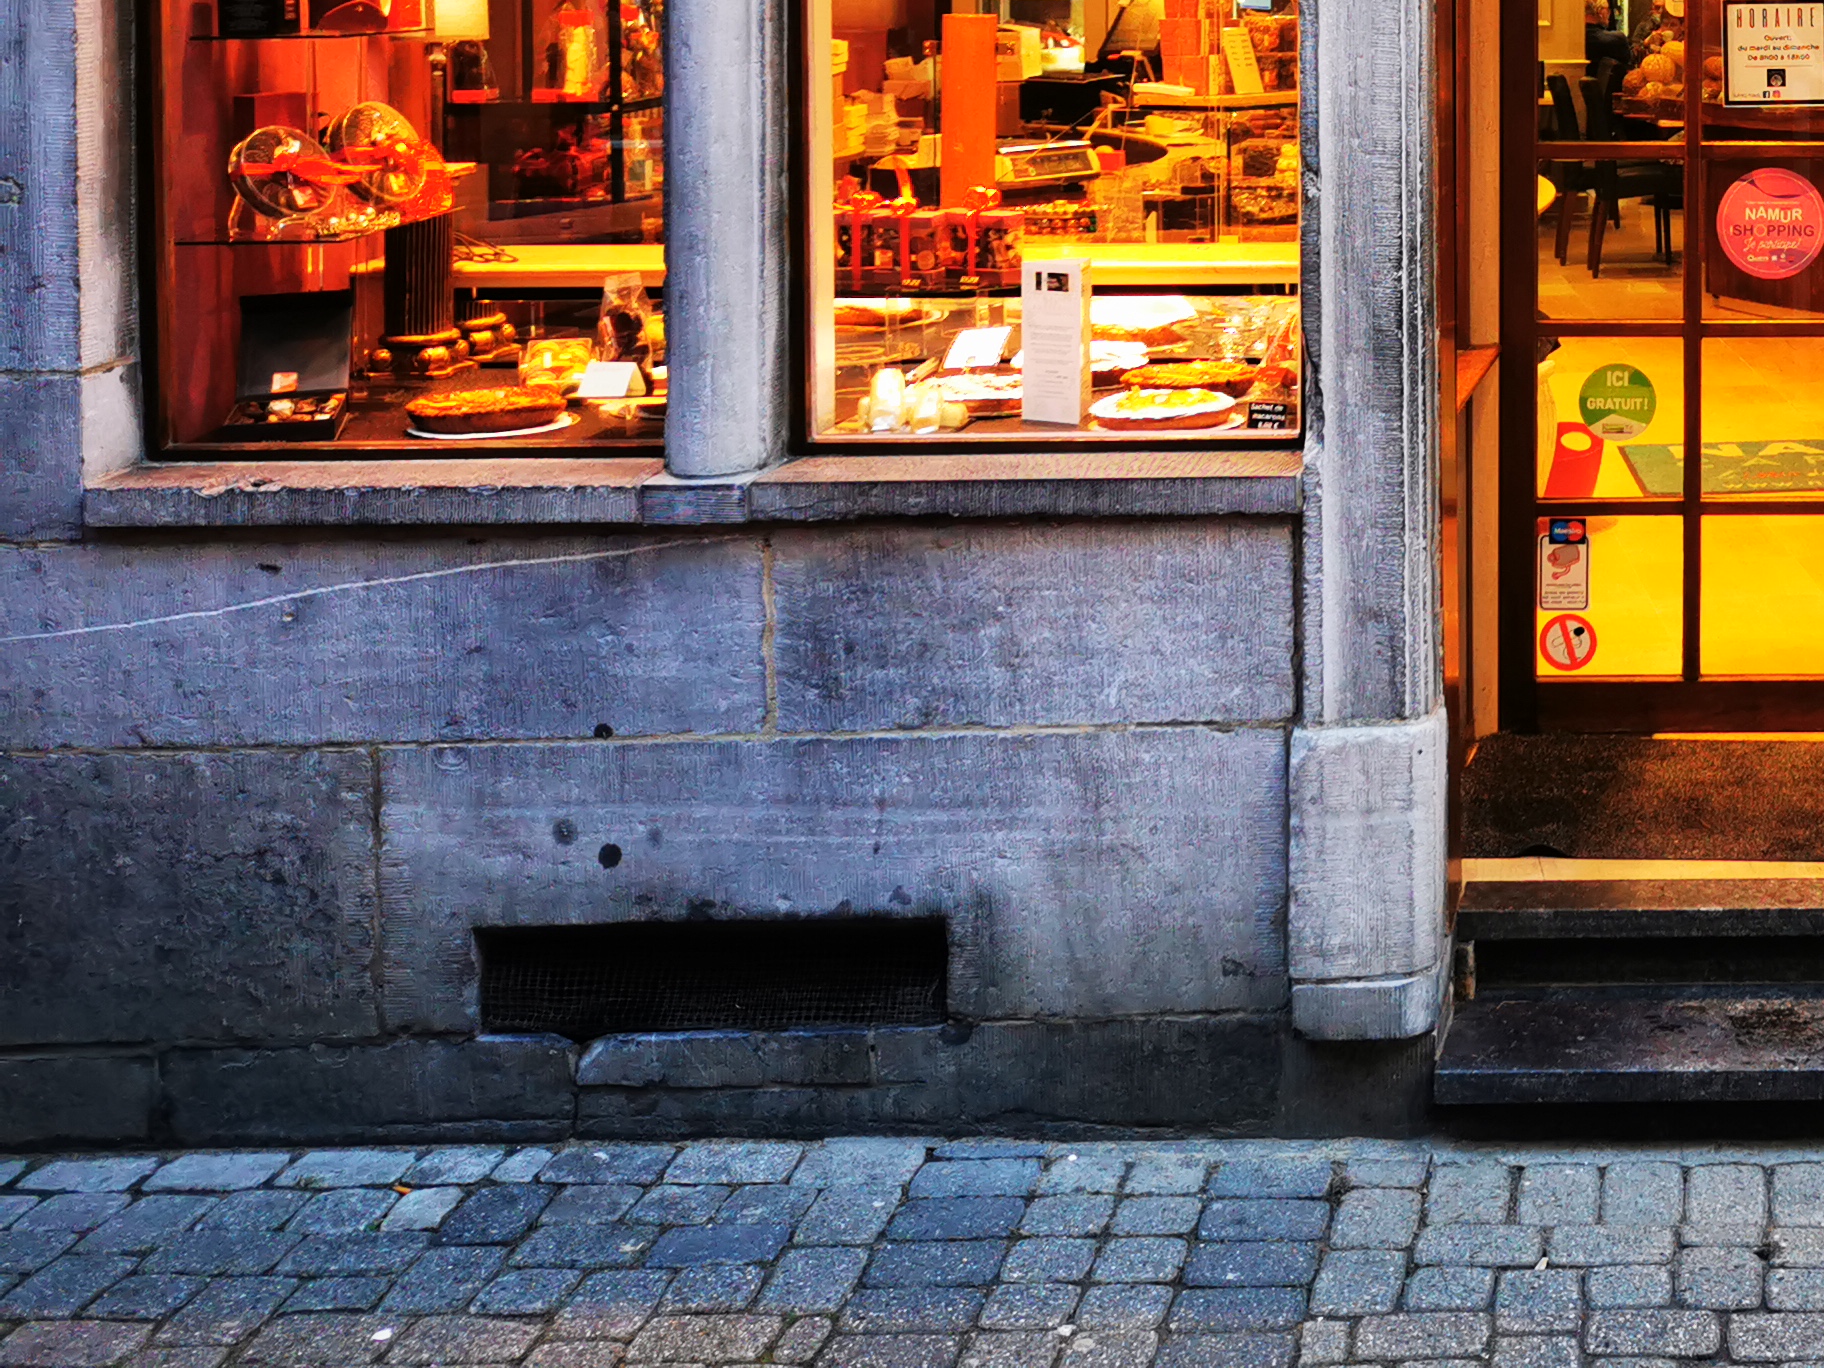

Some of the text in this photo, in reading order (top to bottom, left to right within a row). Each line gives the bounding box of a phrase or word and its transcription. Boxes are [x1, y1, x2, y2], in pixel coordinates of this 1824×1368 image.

[1736, 6, 1815, 28] HORAIRE
[1745, 206, 1802, 223] NAMUR
[1732, 224, 1815, 237] SHOPPING
[1743, 237, 1756, 252] Je
[1606, 371, 1629, 387] ICI
